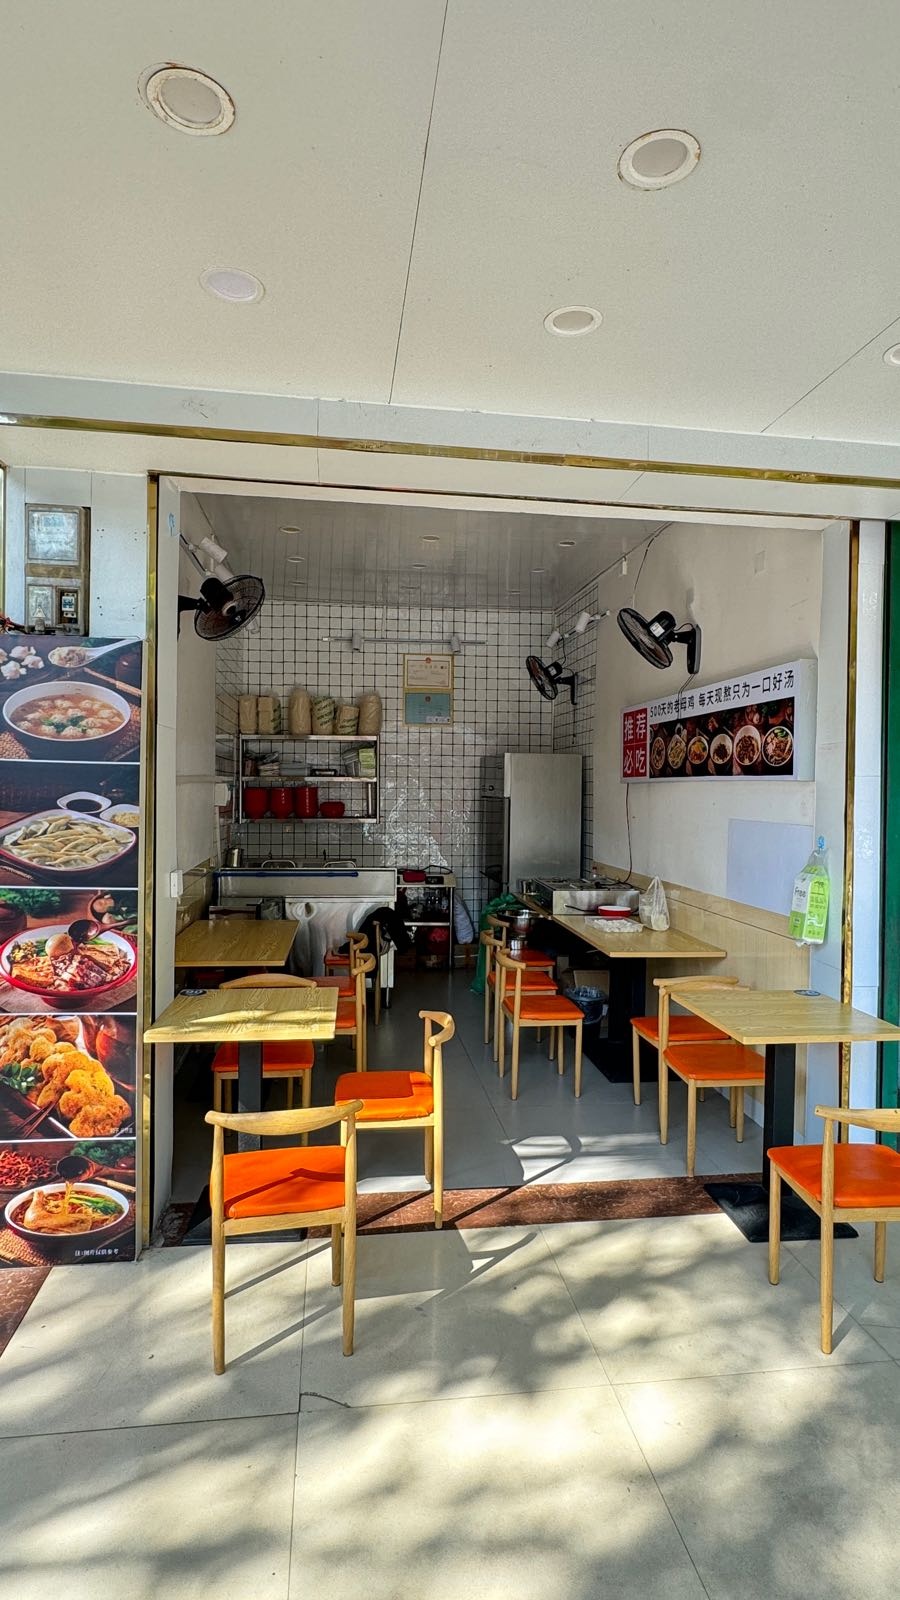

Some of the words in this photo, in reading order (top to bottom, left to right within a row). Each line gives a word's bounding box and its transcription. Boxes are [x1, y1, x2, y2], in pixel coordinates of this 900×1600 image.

[698, 669, 795, 707] 每天现熬只为一口好汤
[624, 713, 646, 741] 推荐
[624, 748, 646, 774] 必吃
